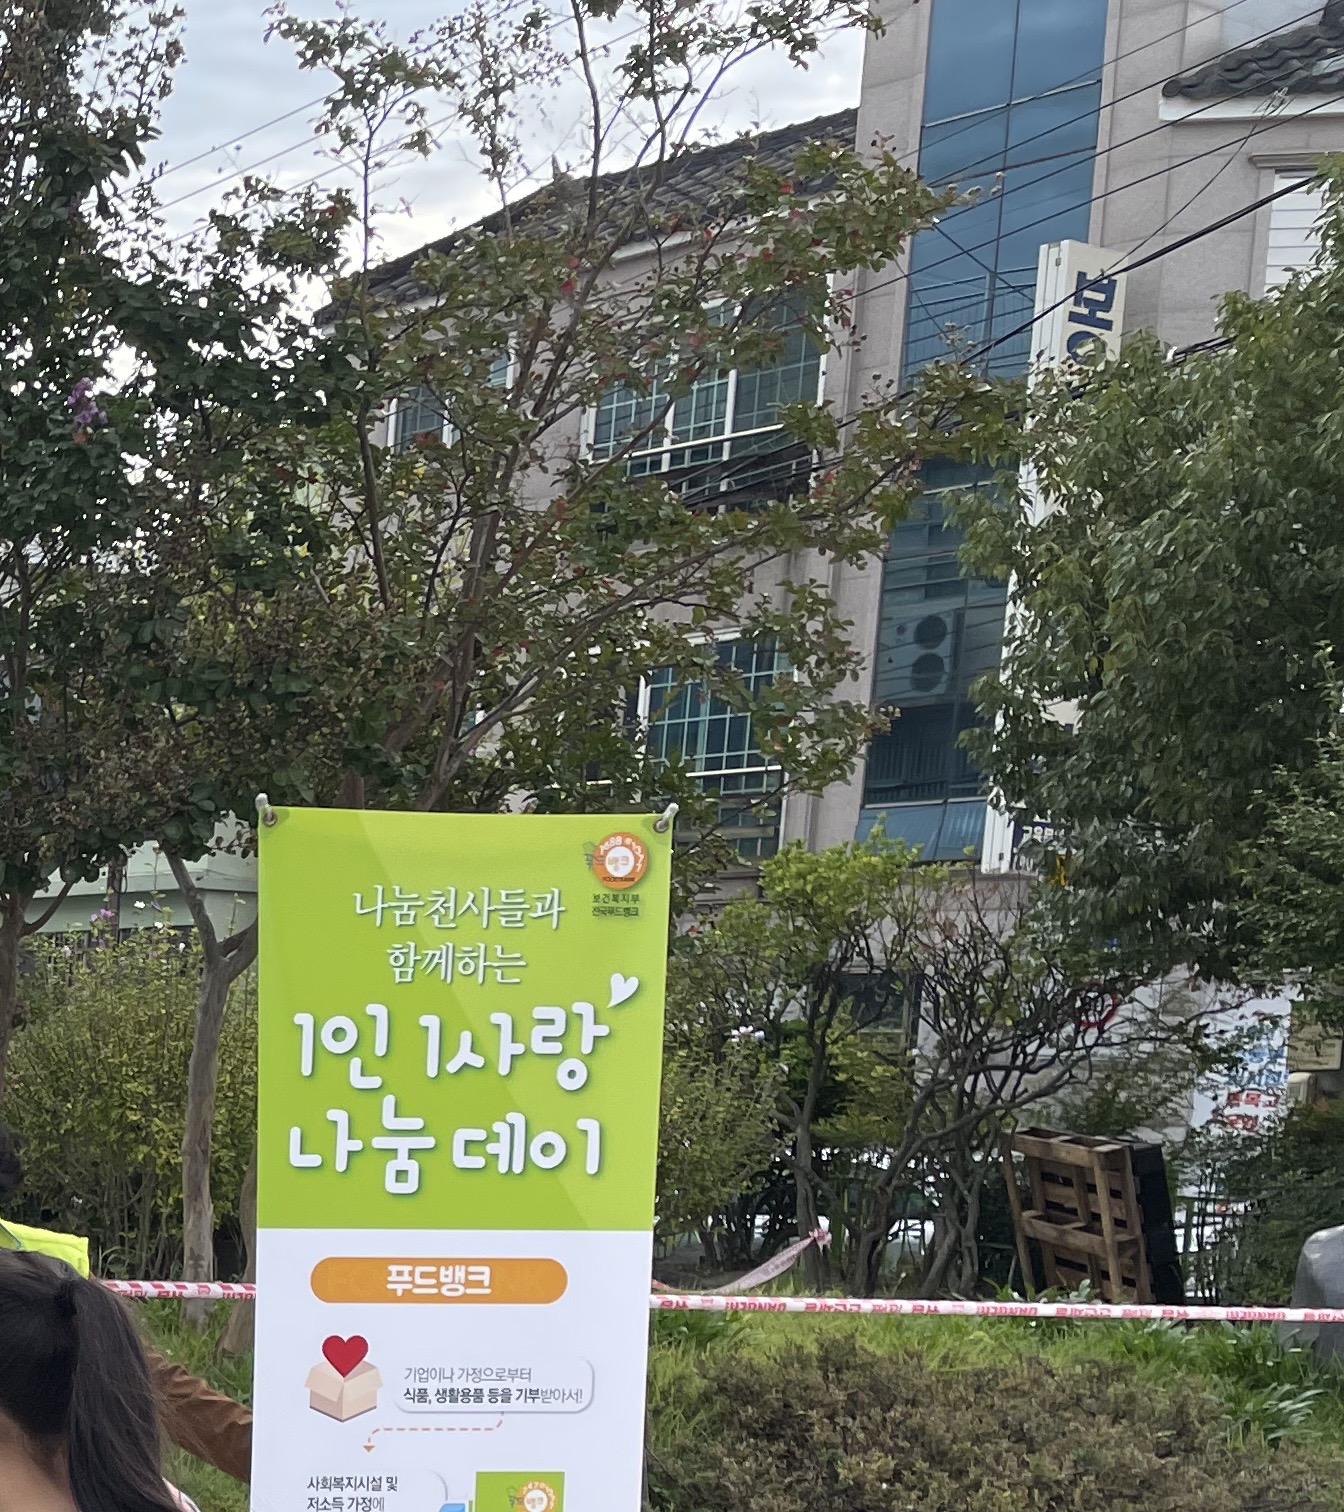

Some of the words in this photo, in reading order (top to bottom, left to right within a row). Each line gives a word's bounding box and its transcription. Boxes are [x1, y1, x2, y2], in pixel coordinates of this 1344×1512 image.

[386, 942, 527, 985] 함께하는
[293, 1003, 389, 1090] 1인
[419, 1001, 610, 1092] 1사랑
[288, 1094, 436, 1195] 나눔
[452, 1111, 602, 1176] 데이
[386, 1264, 493, 1297] 푸드뱅크
[404, 1367, 455, 1383] 기업이나
[457, 1367, 532, 1383] 가정으로부터
[404, 1388, 432, 1405] 식품,
[434, 1388, 485, 1404] 생활용품
[487, 1388, 513, 1404] 등을
[515, 1388, 583, 1404] 기부받아서!
[307, 1476, 383, 1492] 사회복지시설
[386, 1476, 398, 1492] 및
[307, 1496, 345, 1512] 저소득
[347, 1496, 385, 1512] 가정에
